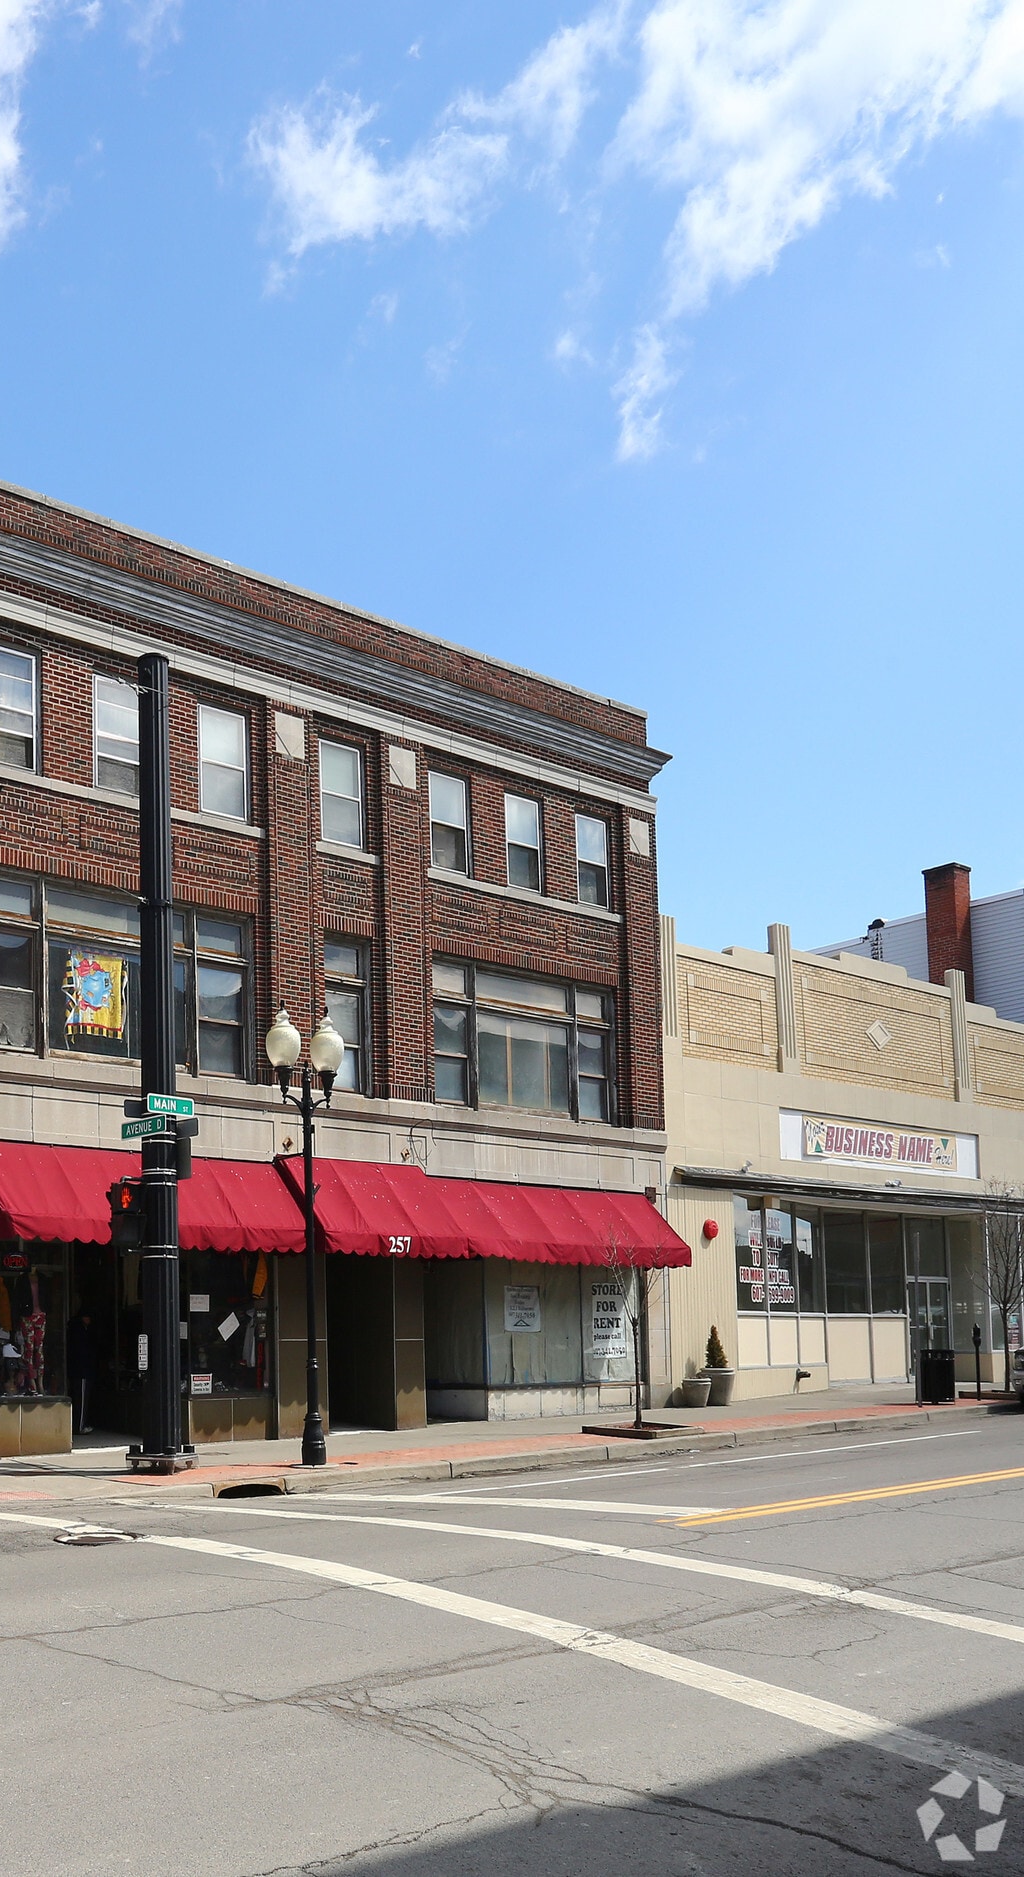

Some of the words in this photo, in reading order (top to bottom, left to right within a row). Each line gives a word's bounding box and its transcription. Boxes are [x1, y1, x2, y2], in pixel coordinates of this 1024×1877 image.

[153, 1097, 177, 1111] MAIN
[126, 1120, 152, 1136] AVENUE
[156, 1119, 162, 1130] D
[825, 1125, 894, 1159] BUSINESS
[897, 1134, 934, 1164] NAME
[934, 1146, 955, 1166] Here!
[388, 1235, 412, 1254] 257
[2, 1255, 29, 1268] OPEN
[753, 1249, 761, 1266] TO
[740, 1267, 750, 1283] FOR
[749, 1267, 764, 1284] MORE
[766, 1269, 778, 1284] NFO
[778, 1269, 790, 1285] CALL
[591, 1284, 624, 1296] STORE
[596, 1300, 618, 1313] FOR
[593, 1317, 622, 1330] RENT
[611, 1332, 622, 1340] call
